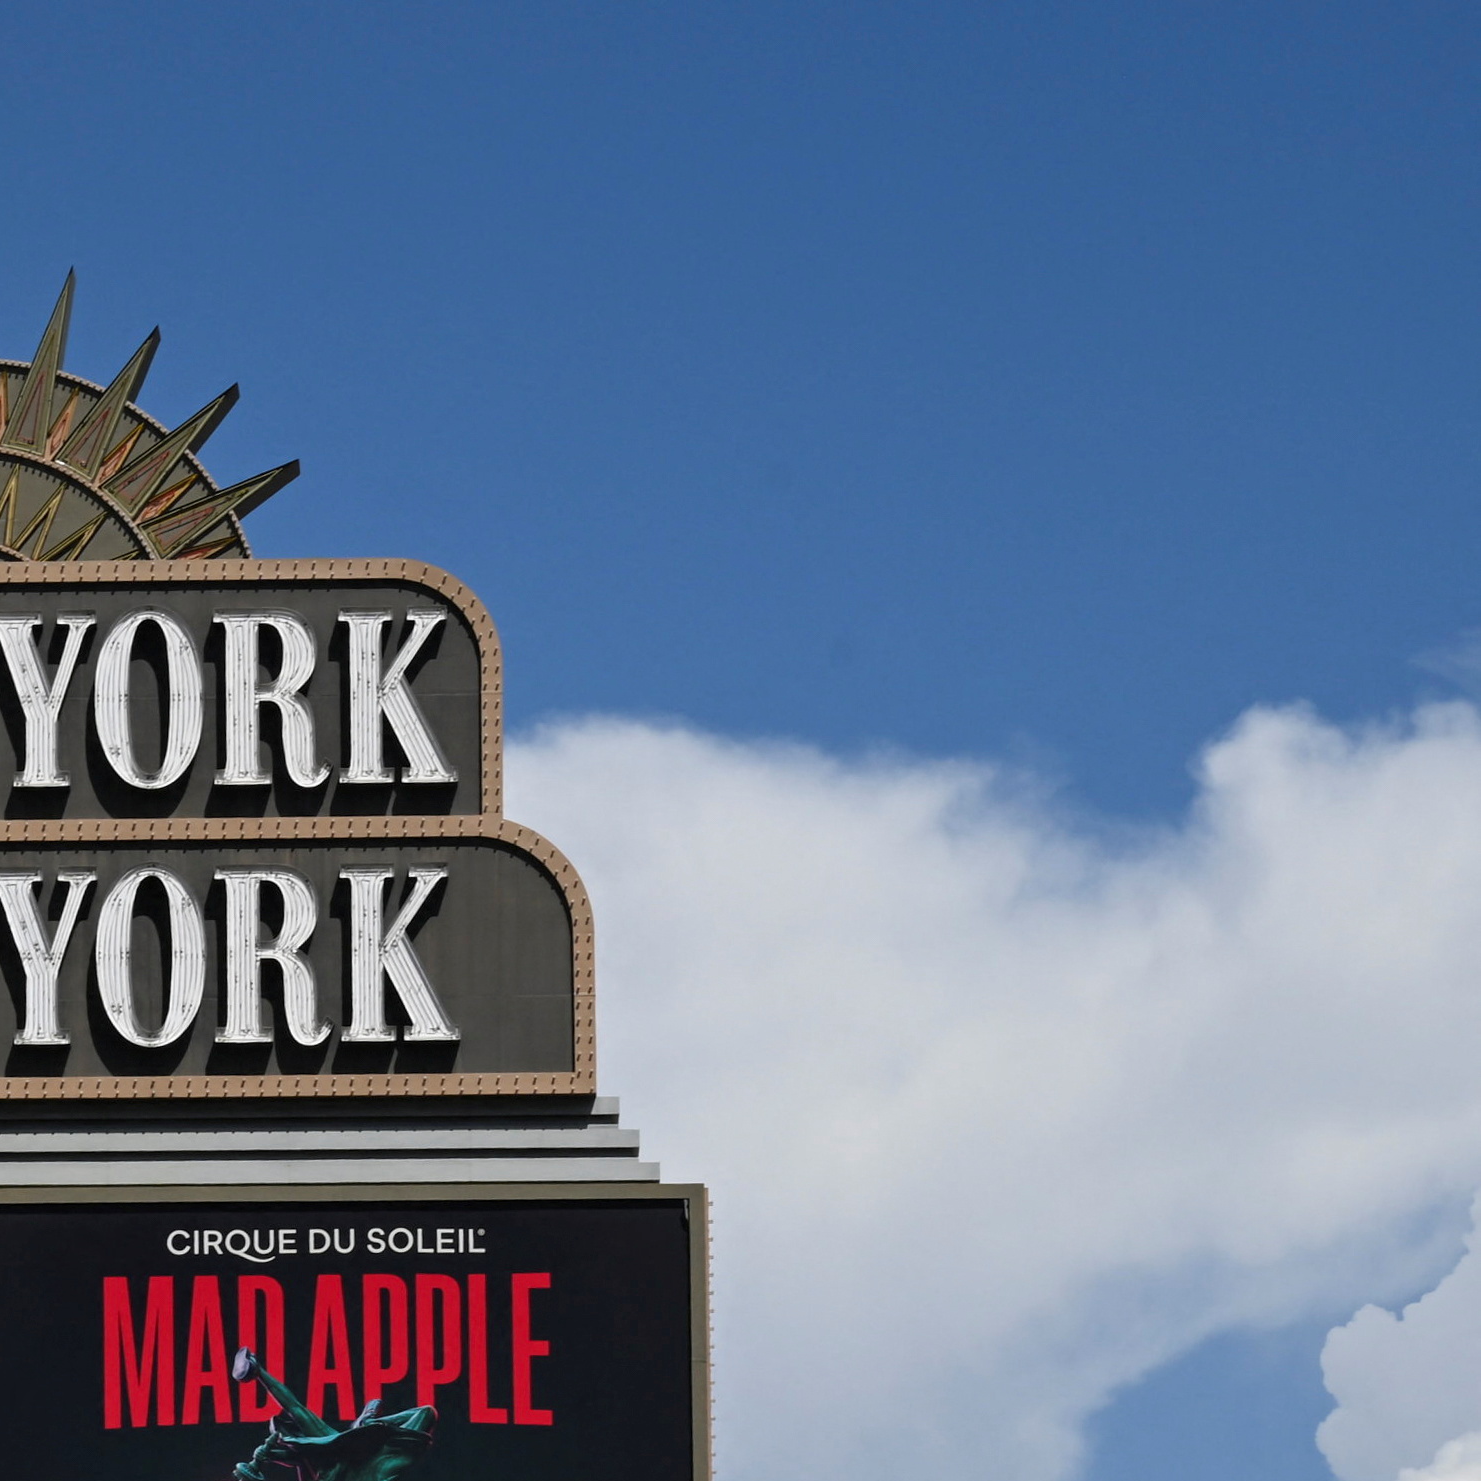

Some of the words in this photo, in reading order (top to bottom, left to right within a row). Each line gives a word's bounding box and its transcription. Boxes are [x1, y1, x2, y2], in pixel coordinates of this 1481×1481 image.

[166, 1228, 298, 1263] CIRQUE
[308, 1227, 356, 1254] DU
[366, 1227, 486, 1254] SOLEIL
[102, 1274, 285, 1430] MAD
[305, 1271, 553, 1426] APPLE
